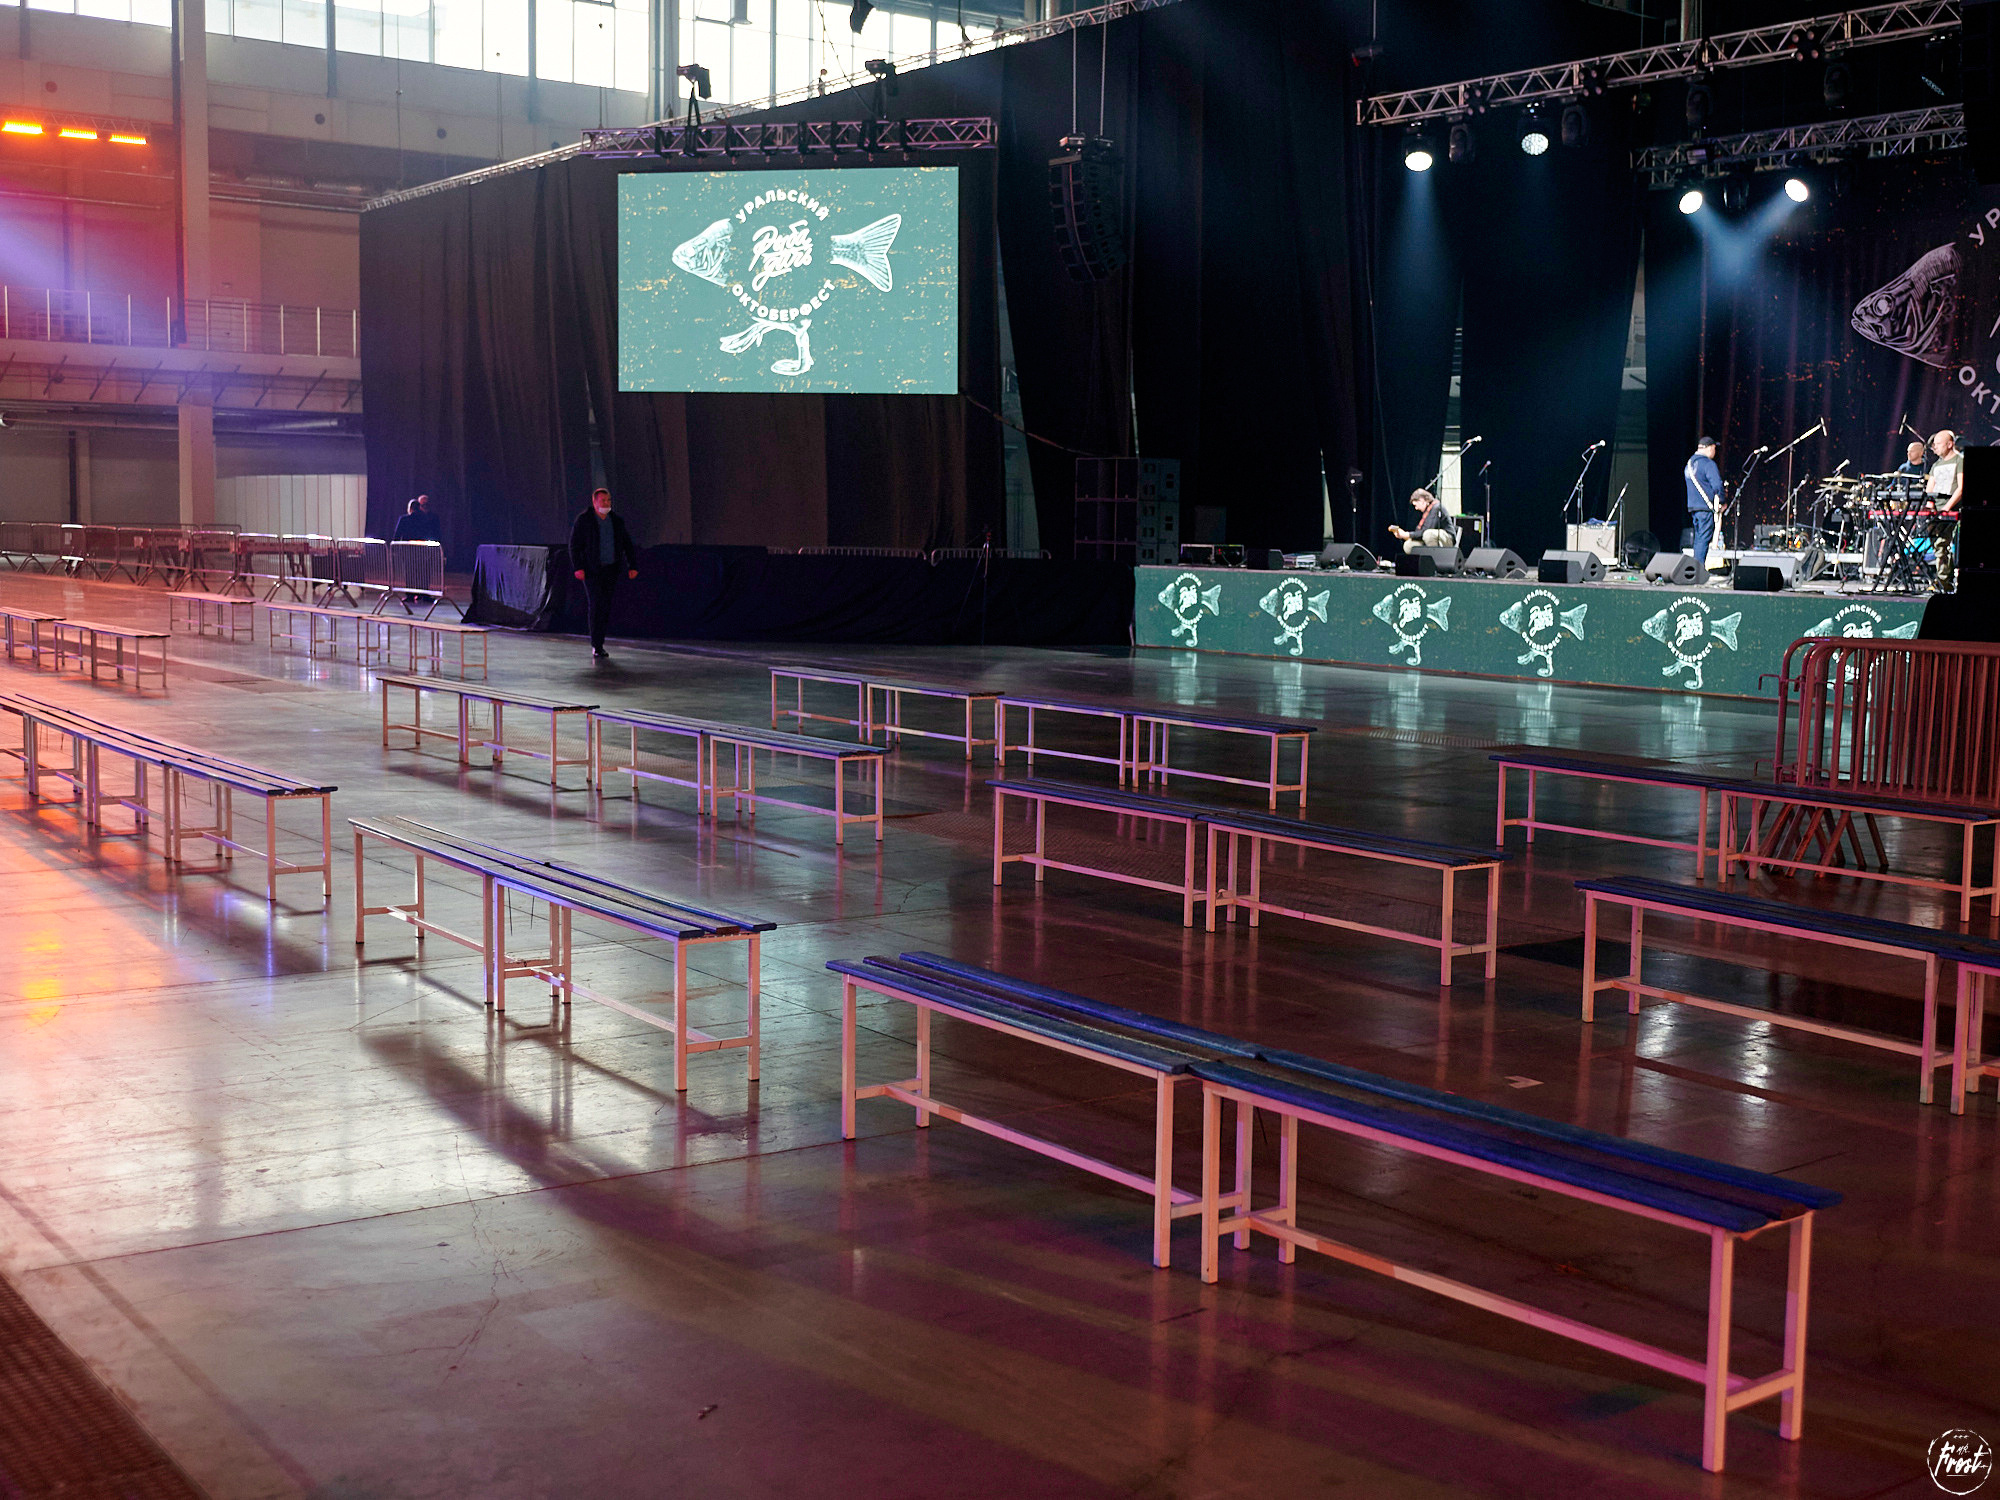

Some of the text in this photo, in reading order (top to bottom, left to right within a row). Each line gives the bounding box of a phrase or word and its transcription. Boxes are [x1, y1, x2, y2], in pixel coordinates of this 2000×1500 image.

[735, 189, 830, 224] УРАЛЬСКИЙ
[732, 279, 836, 322] ОКТОБЕРФЕСТ
[1669, 595, 1711, 615] УРАЛЬСКИЙ
[1834, 603, 1882, 624] УРАЛЬСКИЙ
